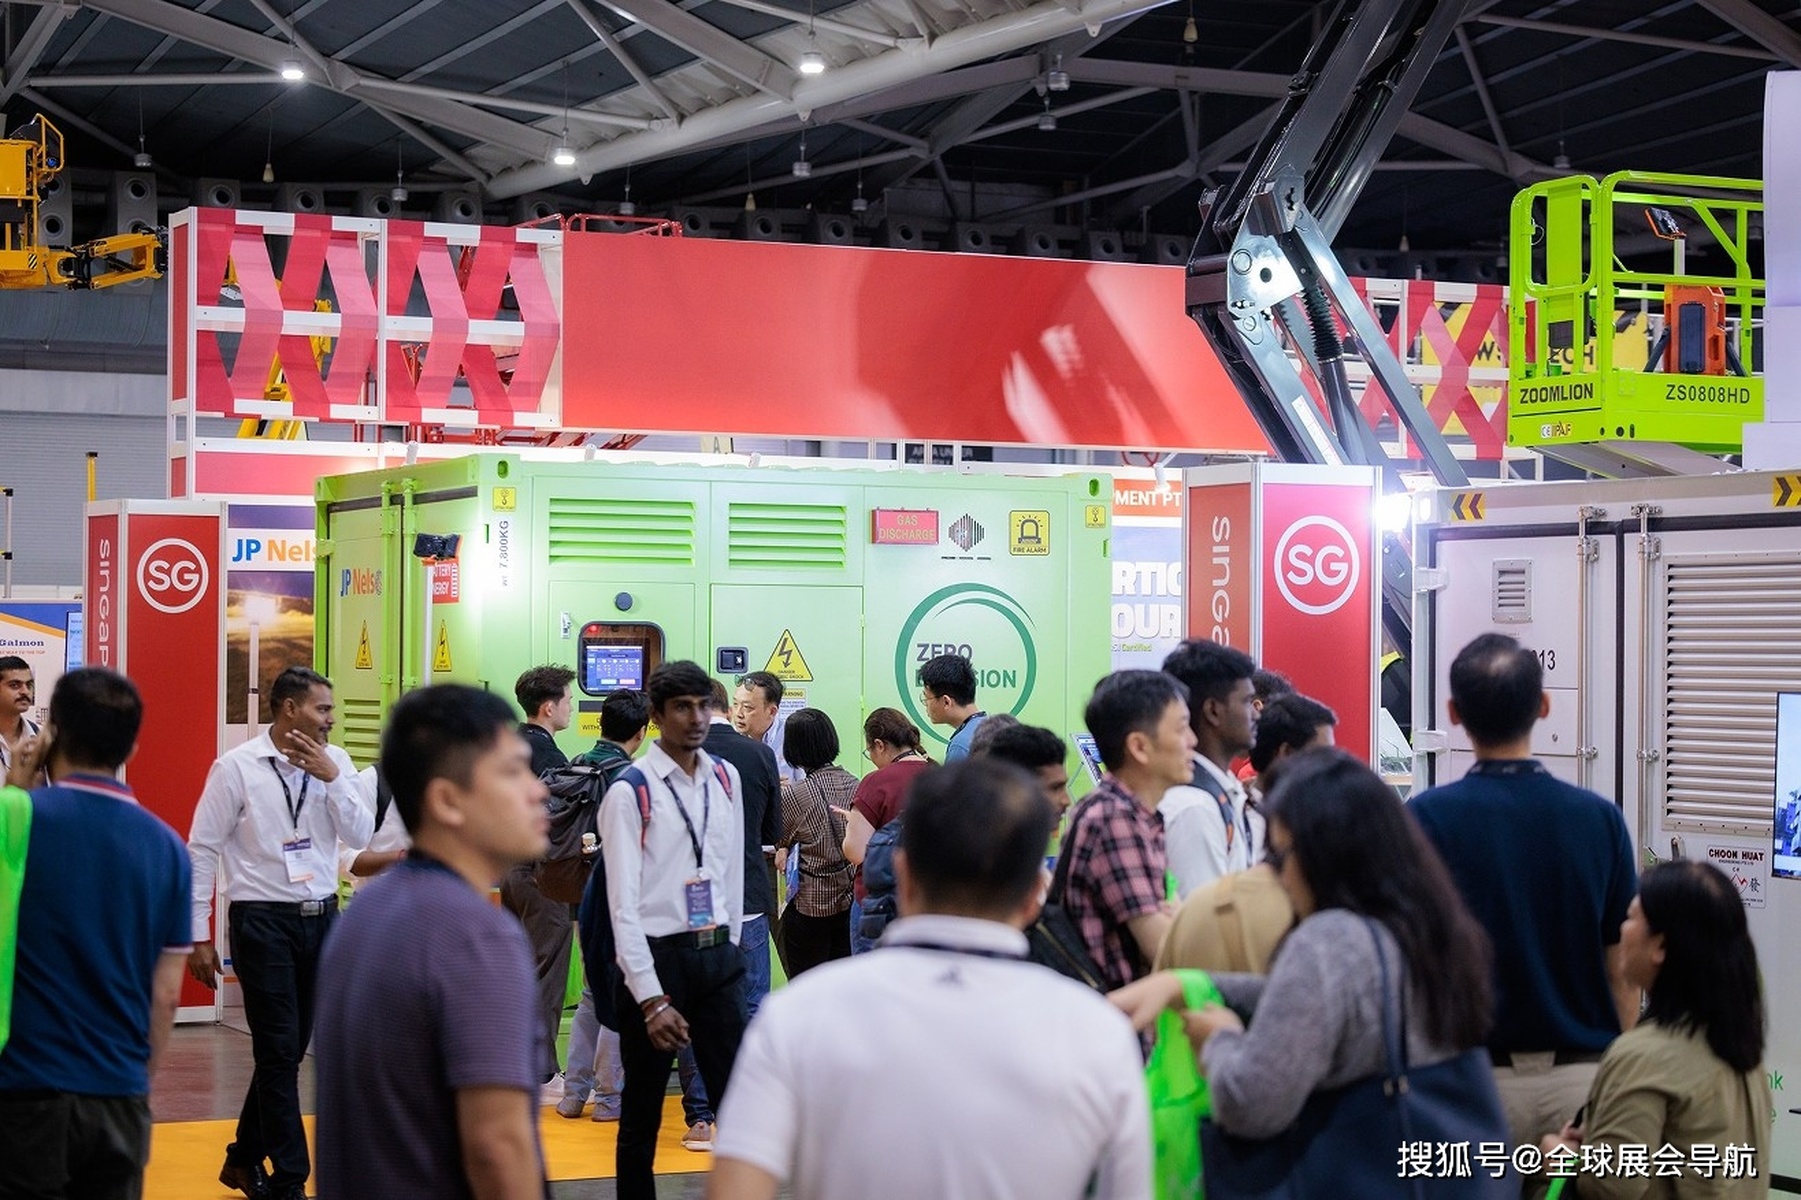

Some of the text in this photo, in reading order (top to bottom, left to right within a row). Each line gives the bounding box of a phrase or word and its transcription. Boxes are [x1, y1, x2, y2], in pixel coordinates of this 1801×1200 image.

[1520, 382, 1594, 404] ZOOMLION
[1666, 384, 1750, 404] ZS0808HD
[897, 514, 918, 527] GAS
[879, 528, 936, 541] DISCHARGE
[232, 538, 262, 563] JP
[147, 559, 201, 592] SG
[1286, 543, 1350, 587] SG
[340, 569, 351, 597] JP
[1531, 649, 1556, 671] 13
[1708, 848, 1765, 862] CHOON HUAT
